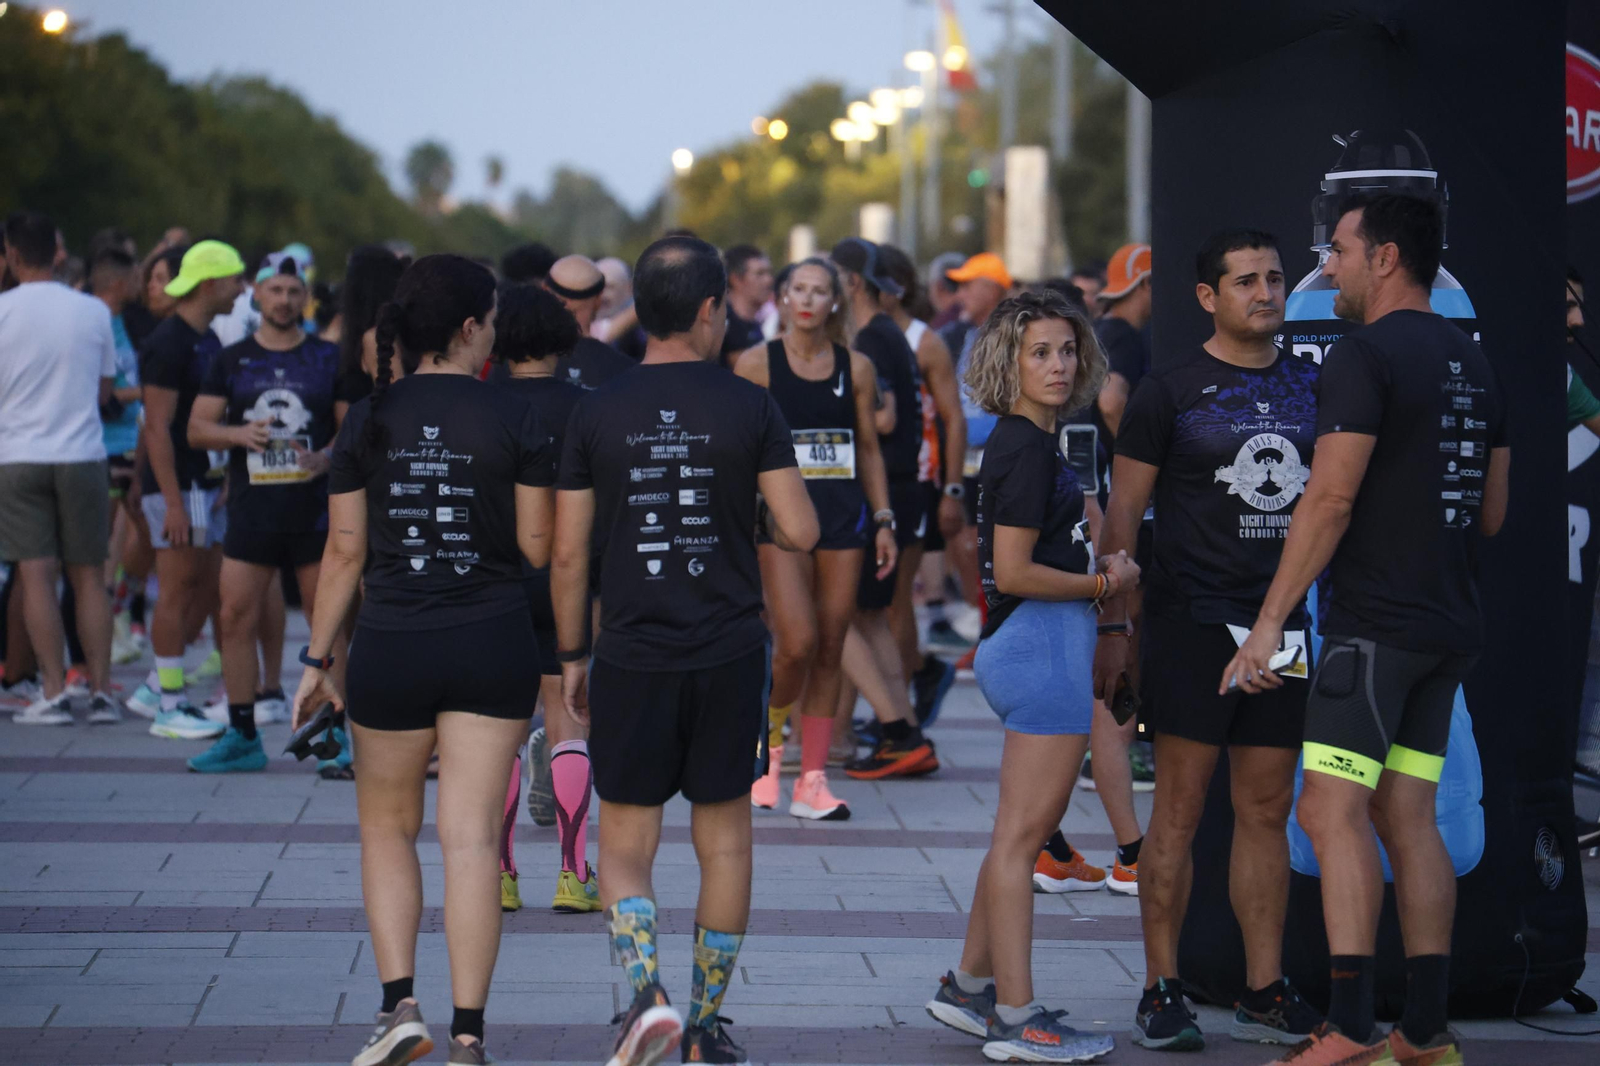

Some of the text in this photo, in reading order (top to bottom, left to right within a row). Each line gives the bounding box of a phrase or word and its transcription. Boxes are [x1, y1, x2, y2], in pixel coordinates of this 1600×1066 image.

[1292, 334, 1344, 343] BOLD HYD
[1231, 421, 1257, 434] Welcome
[1275, 421, 1301, 434] Running
[626, 432, 659, 447] Welcome
[666, 431, 678, 444] the
[679, 431, 711, 445] Running
[387, 448, 419, 462] Welcome
[427, 448, 439, 461] the
[440, 448, 473, 465] Running
[809, 443, 837, 462] 403
[410, 462, 449, 471] NIGHT RUNNING
[636, 492, 670, 503] IMDECO
[1249, 493, 1288, 510] RUNNERS
[398, 508, 428, 517] IMDECO
[1239, 514, 1292, 527] NIGHT RUNNIN
[1239, 525, 1288, 538] CÓRDOBA 20
[674, 535, 720, 547] MIRANZA
[1318, 759, 1366, 778] HANKER
